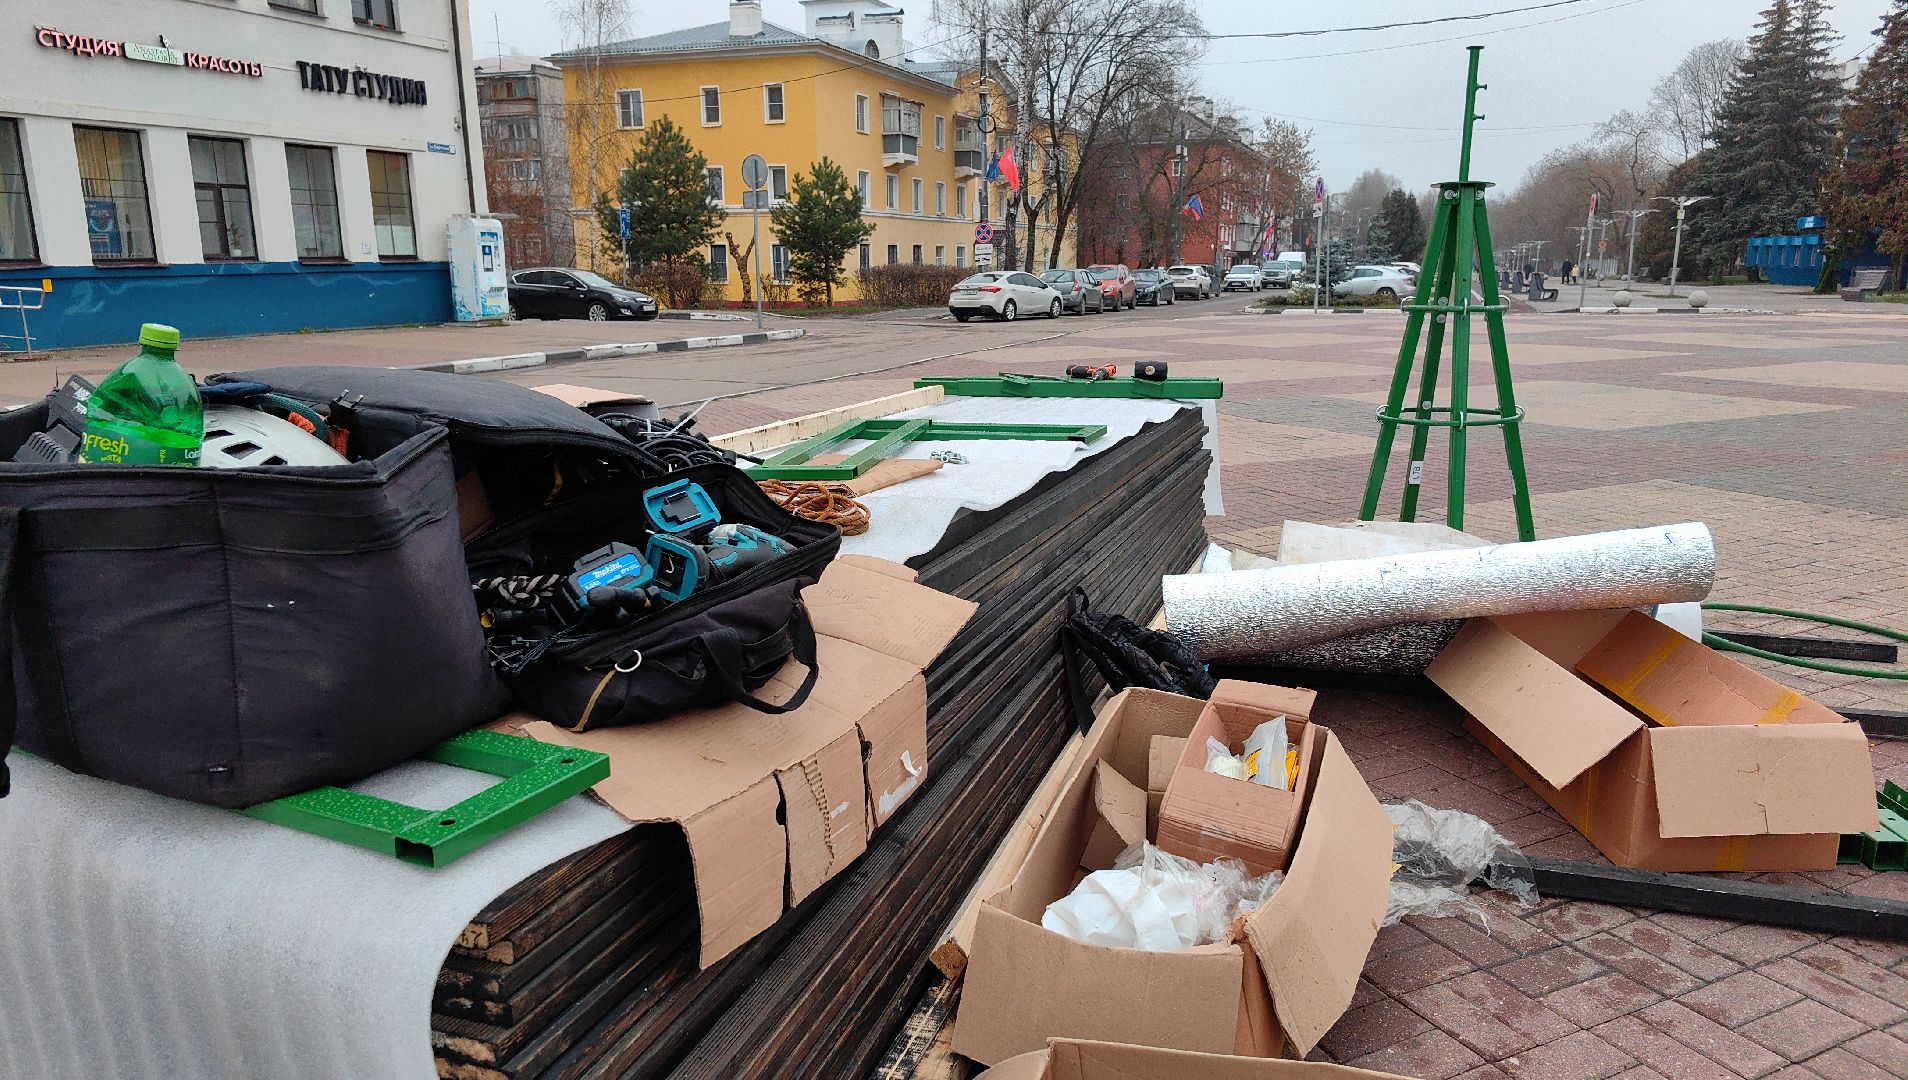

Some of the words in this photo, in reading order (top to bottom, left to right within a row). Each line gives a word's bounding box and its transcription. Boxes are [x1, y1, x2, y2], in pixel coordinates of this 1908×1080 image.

[37, 29, 121, 57] СТУДИЯ
[187, 53, 264, 77] КРАСОТЫ
[296, 61, 349, 94] ТАТУ
[352, 71, 428, 105] СТУДИЯ
